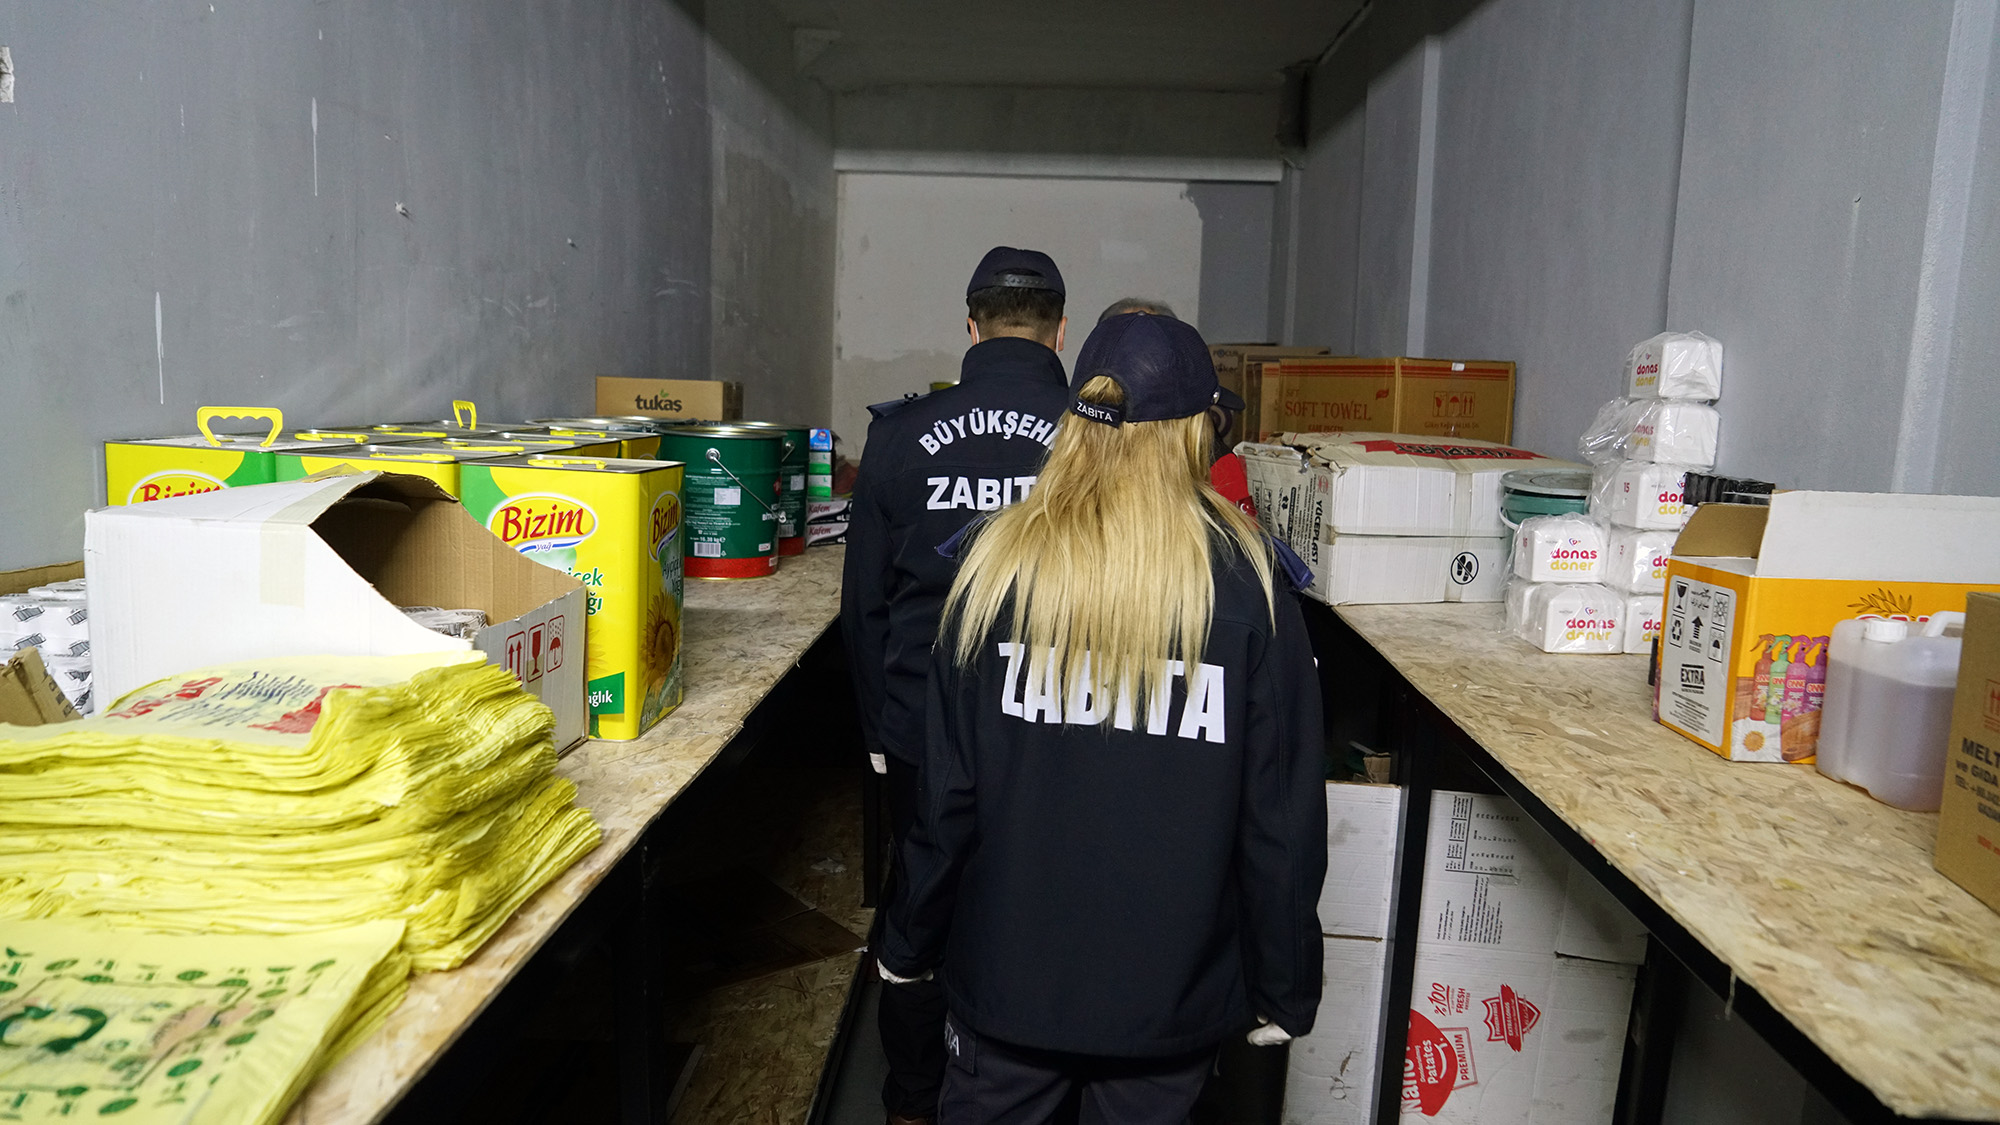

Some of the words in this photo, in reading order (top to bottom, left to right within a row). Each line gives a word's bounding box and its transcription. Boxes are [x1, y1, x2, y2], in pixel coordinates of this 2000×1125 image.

[1636, 364, 1658, 375] donas
[635, 394, 683, 413] tukaş
[1077, 401, 1113, 422] ZABITA
[1285, 401, 1318, 417] SOFT
[1321, 401, 1372, 421] TOWEL
[926, 476, 1037, 511] ZABIT
[500, 504, 584, 543] Bizim
[652, 500, 679, 545] Bizim
[1550, 548, 1598, 559] donas
[1550, 560, 1594, 571] döner
[1566, 618, 1615, 629] donas
[1681, 668, 1705, 686] EXTRA
[1962, 737, 2000, 769] MELT
[1456, 988, 1466, 1014] FRESH
[1423, 1039, 1439, 1084] Patates
[1454, 1034, 1470, 1081] PREMIUM
